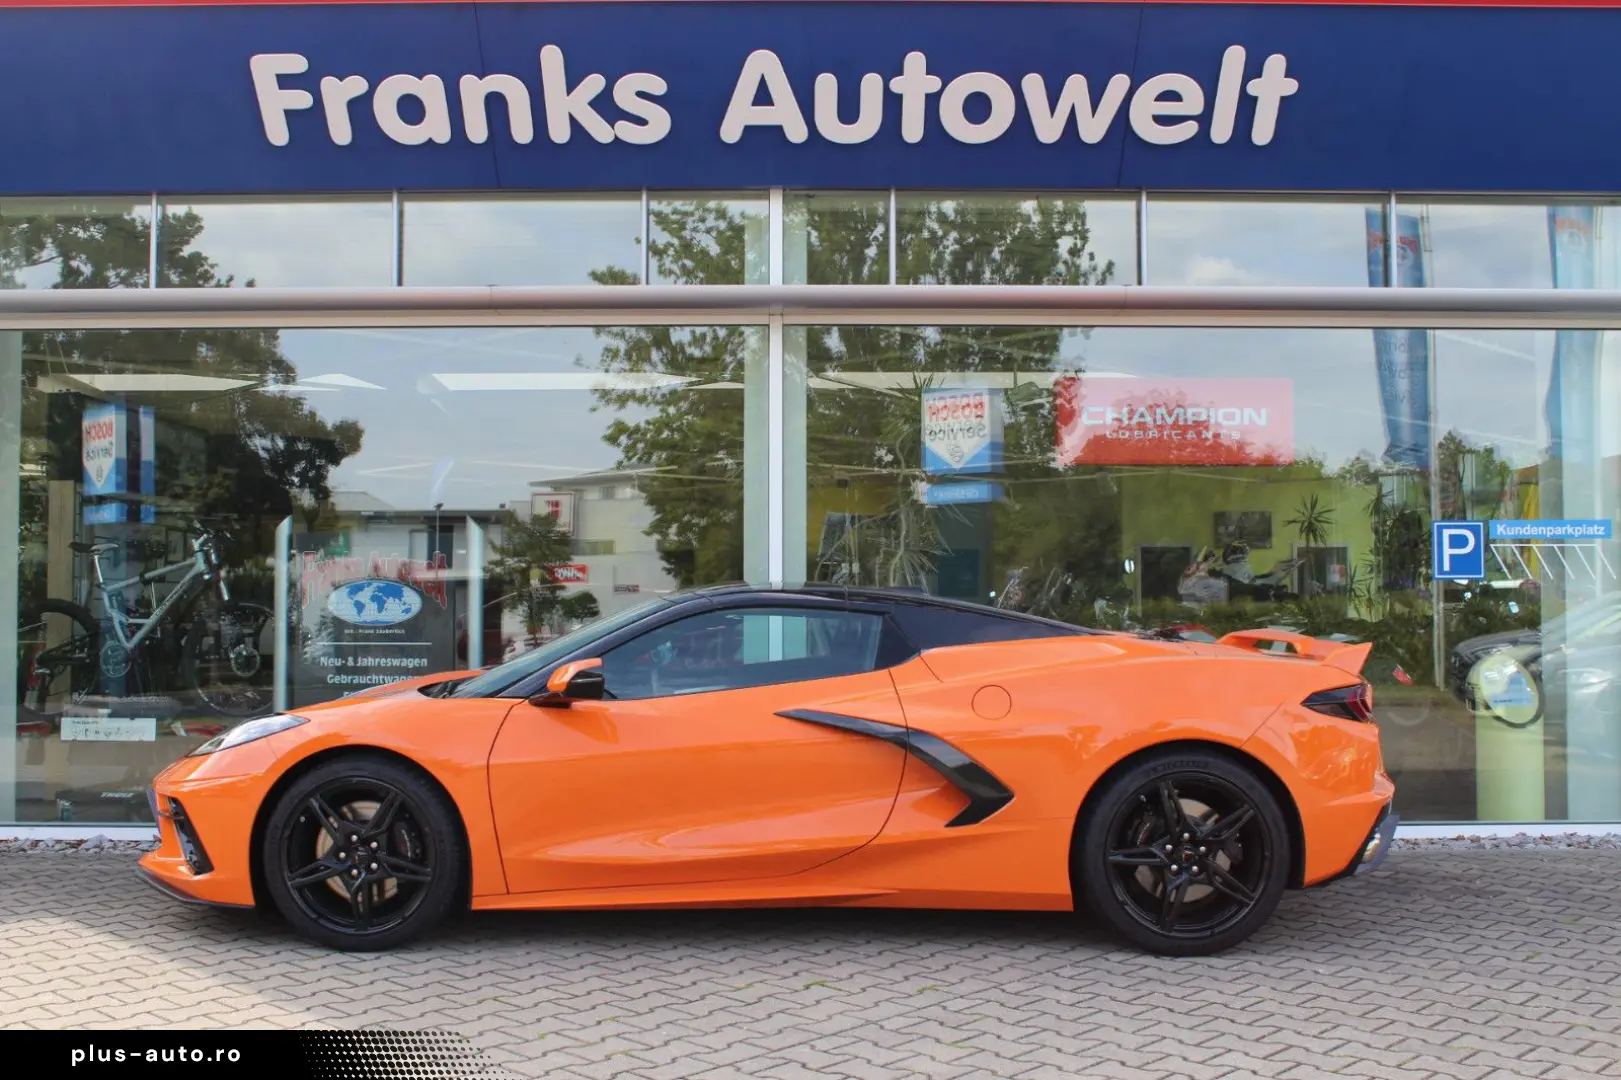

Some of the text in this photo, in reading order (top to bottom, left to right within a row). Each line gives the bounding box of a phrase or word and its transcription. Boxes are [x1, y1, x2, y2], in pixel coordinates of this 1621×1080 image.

[249, 44, 1299, 147] Franks Autowelt
[1081, 407, 1268, 426] CHAMPION
[1106, 430, 1241, 440] LUBRICANTS
[1496, 523, 1605, 537] Kundenparkplatz
[1442, 528, 1476, 572] P
[320, 656, 428, 668] Neu- & Jahreswagen
